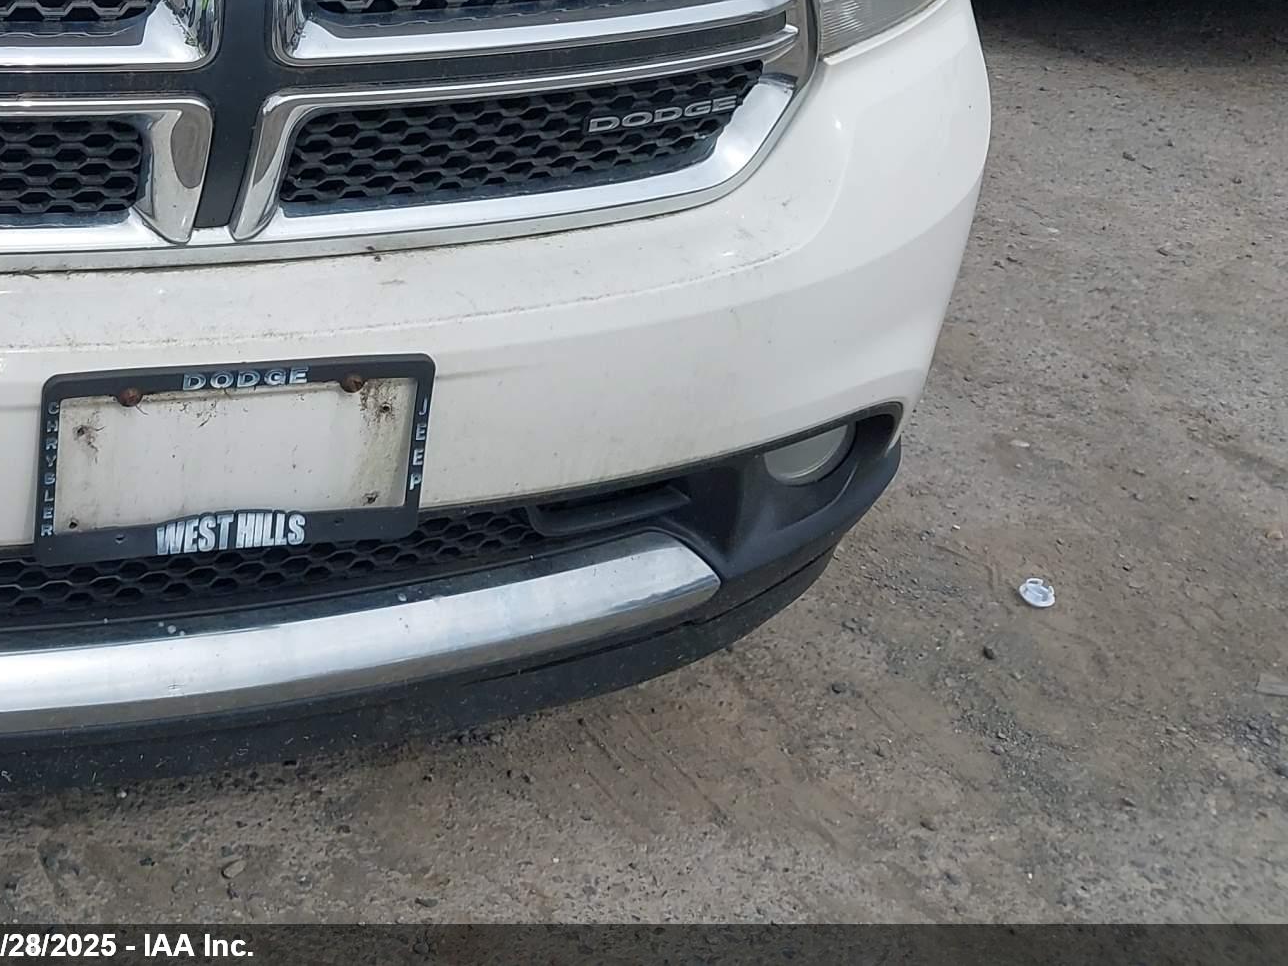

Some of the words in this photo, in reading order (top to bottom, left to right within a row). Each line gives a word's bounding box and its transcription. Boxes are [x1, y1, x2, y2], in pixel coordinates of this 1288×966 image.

[588, 95, 738, 133] DODGE
[182, 367, 310, 391] DODGE
[409, 397, 428, 491] JEEP
[156, 514, 235, 556] WEST
[235, 512, 306, 549] HILLS
